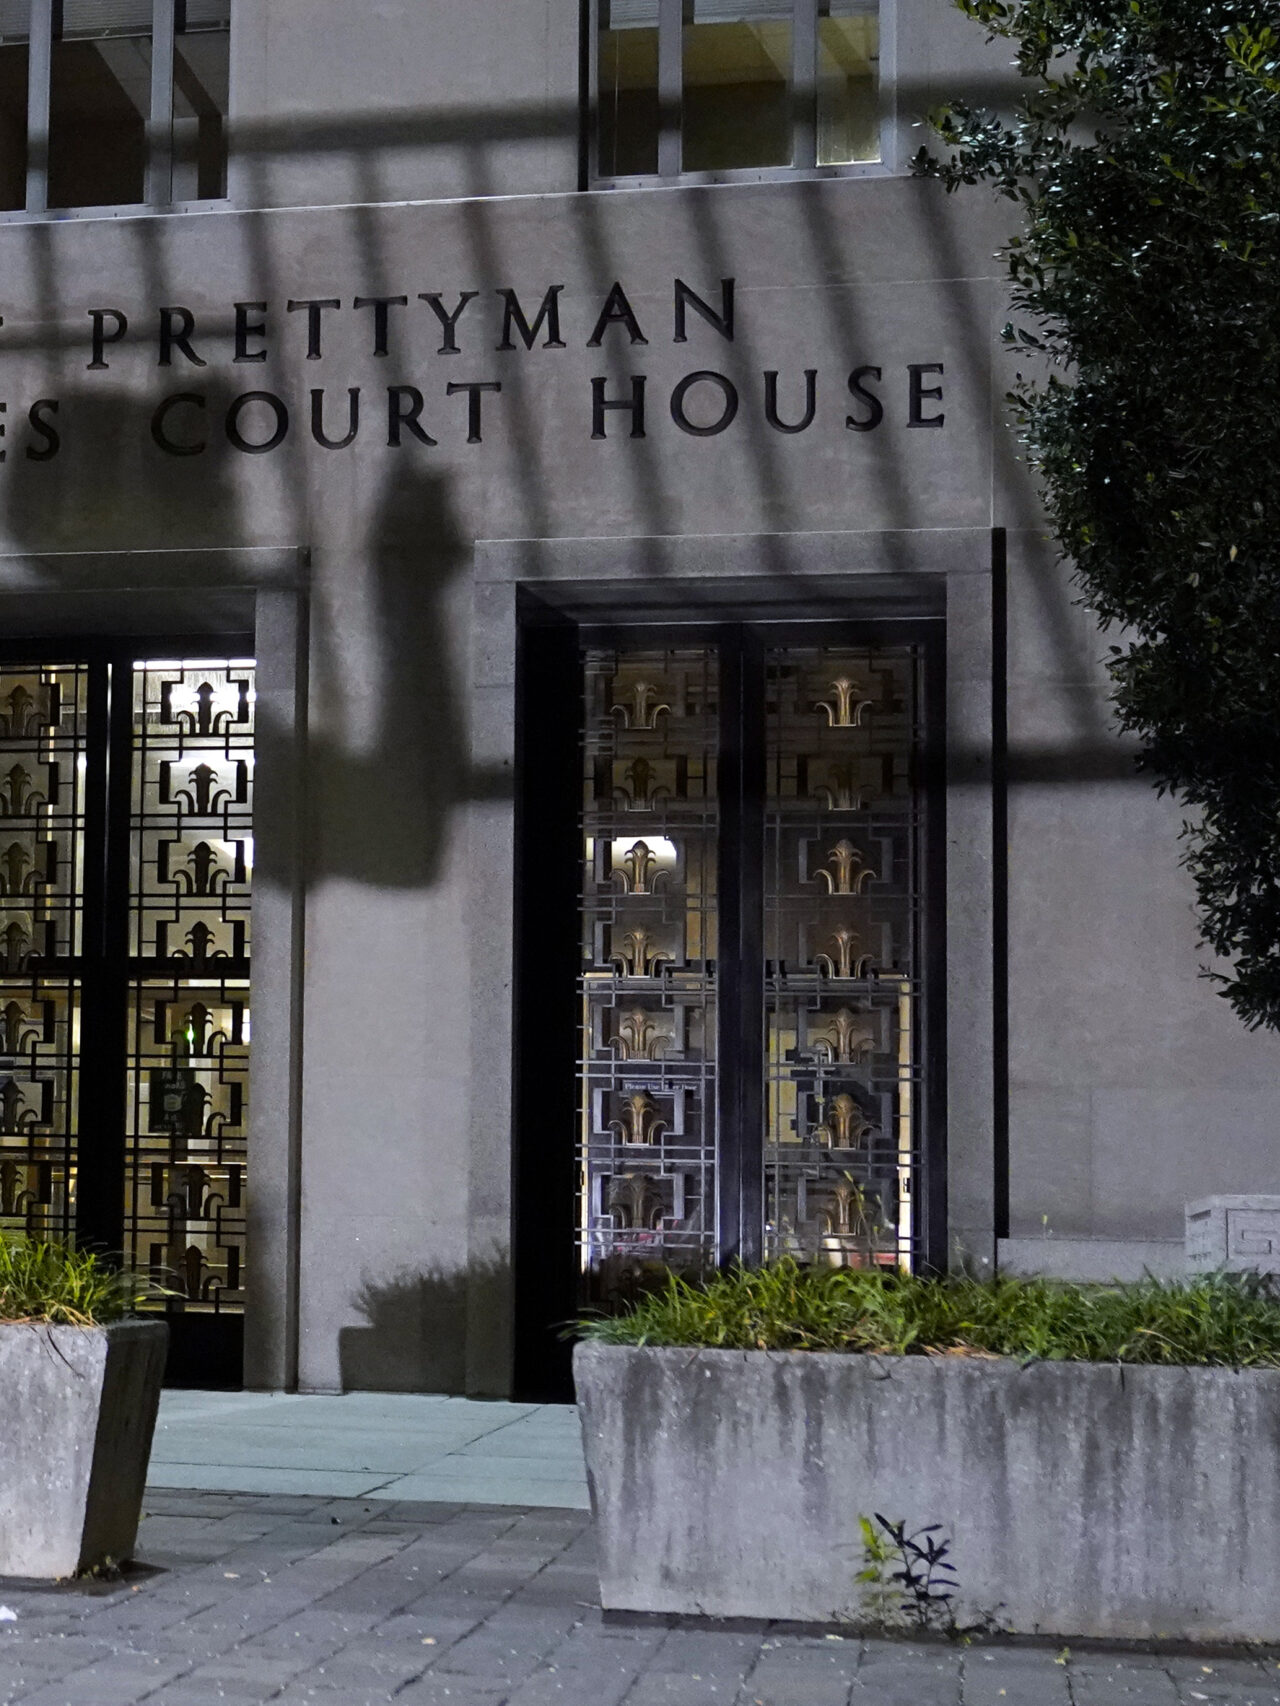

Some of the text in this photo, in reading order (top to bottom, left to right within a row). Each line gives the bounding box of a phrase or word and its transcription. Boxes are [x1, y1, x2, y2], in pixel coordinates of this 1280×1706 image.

[86, 277, 736, 370] PRETTYMAN
[150, 381, 502, 457] COURT
[590, 363, 945, 440] HOUSE
